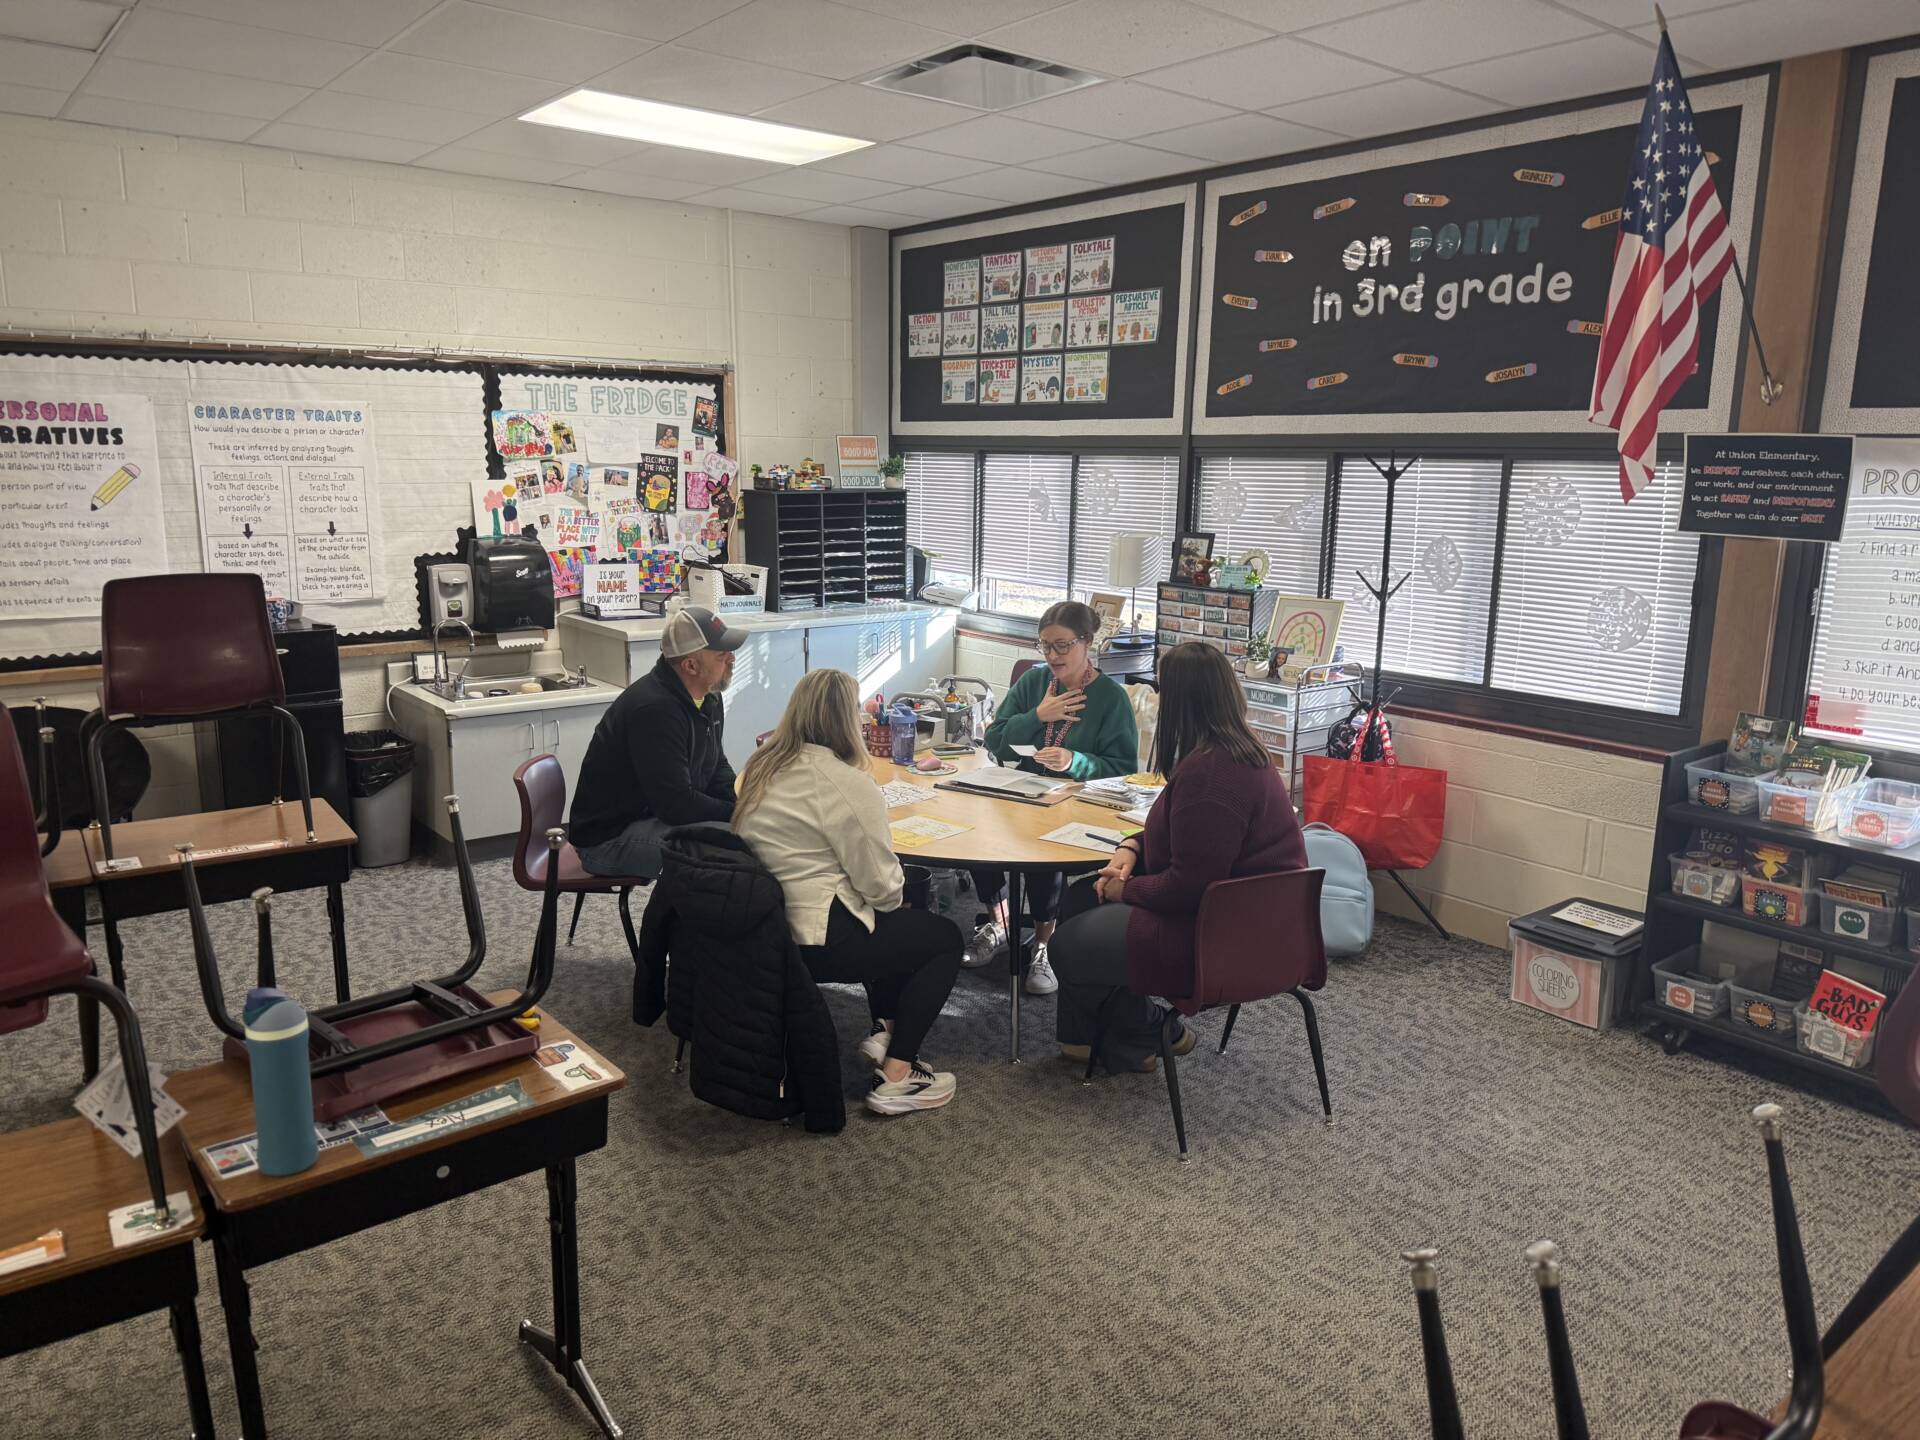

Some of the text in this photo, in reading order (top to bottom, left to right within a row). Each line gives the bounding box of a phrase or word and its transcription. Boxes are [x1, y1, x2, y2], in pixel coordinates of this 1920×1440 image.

[1409, 216, 1539, 262] POINT
[1072, 240, 1111, 255] FOLKTALE
[985, 255, 1018, 267] FANTASY
[1115, 291, 1159, 304] PERSUASIVE
[1312, 262, 1573, 324] in 3rd grade
[985, 308, 999, 317] TALL
[1001, 306, 1016, 316] TALE
[1124, 301, 1148, 311] ARTICLE
[913, 315, 937, 324] FICTION
[981, 360, 1016, 371] TRICKSTER
[1023, 357, 1060, 367] MYSTERY
[995, 370, 1010, 379] TALE
[524, 383, 577, 412] THE
[590, 385, 688, 416] FRIDGE
[194, 405, 362, 422] CHARACTER TRAITS
[194, 424, 209, 432] How
[212, 424, 234, 433] would
[236, 427, 249, 436] you
[252, 426, 281, 435] describe
[294, 428, 317, 437] person
[208, 442, 230, 451] These
[247, 444, 278, 452] inferred
[281, 445, 289, 453] by
[292, 445, 324, 455] analyzing
[844, 447, 876, 457] GOOD DAY
[290, 454, 304, 462] and
[1715, 451, 1726, 459] At
[1728, 451, 1755, 459] Union
[644, 463, 654, 471] THE
[1690, 467, 1702, 475] We
[1791, 469, 1813, 478] each
[213, 472, 272, 480] Internal Traits
[298, 472, 354, 480] External Traits
[843, 476, 876, 486] GOOD DAY
[2, 481, 87, 491] person point of view
[229, 482, 244, 491] that
[246, 483, 279, 491] describe
[331, 483, 346, 491] that
[1737, 481, 1754, 489] and
[1774, 483, 1834, 492] environment
[1862, 468, 1920, 496] PRO
[226, 493, 271, 502] character's
[298, 494, 332, 502] describe
[334, 494, 349, 502] how
[1753, 497, 1770, 505] and
[219, 504, 261, 514] personality
[299, 505, 359, 513] character looks
[1696, 509, 1732, 519] Together
[1748, 513, 1765, 521] can
[1768, 513, 1778, 521] do
[22, 520, 110, 531] thoughts and feelings
[573, 517, 599, 526] BETTER
[557, 524, 580, 533] PLACE
[1871, 541, 1896, 557] Find
[1900, 543, 1907, 557] a
[596, 580, 628, 593] NAME
[735, 600, 762, 608] JOURNALS
[1250, 689, 1274, 703] MONDAY
[1532, 963, 1574, 989] COLORING
[1538, 978, 1567, 1000] SHEETS
[1830, 988, 1871, 1014] BAD
[1817, 998, 1867, 1030] GUYS
